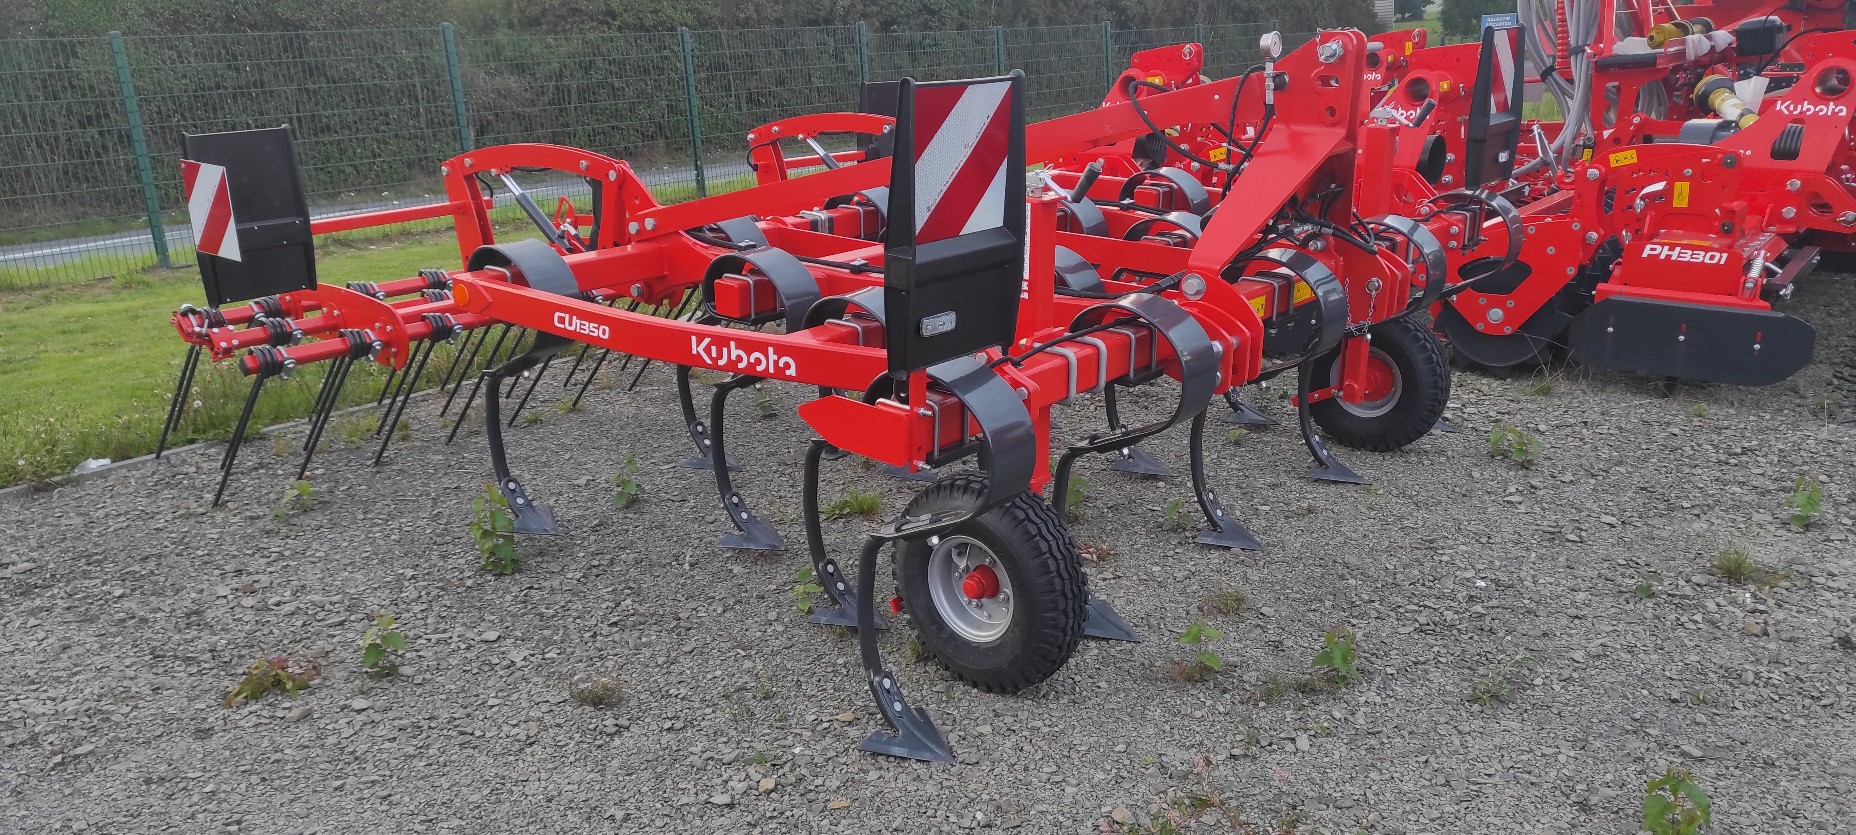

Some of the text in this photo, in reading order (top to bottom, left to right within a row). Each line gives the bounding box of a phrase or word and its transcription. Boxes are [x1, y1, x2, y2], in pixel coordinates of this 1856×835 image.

[1776, 100, 1847, 116] Kubota
[1641, 244, 1728, 265] PH3301
[553, 311, 610, 340] CU1350
[691, 335, 797, 377] Kubota
